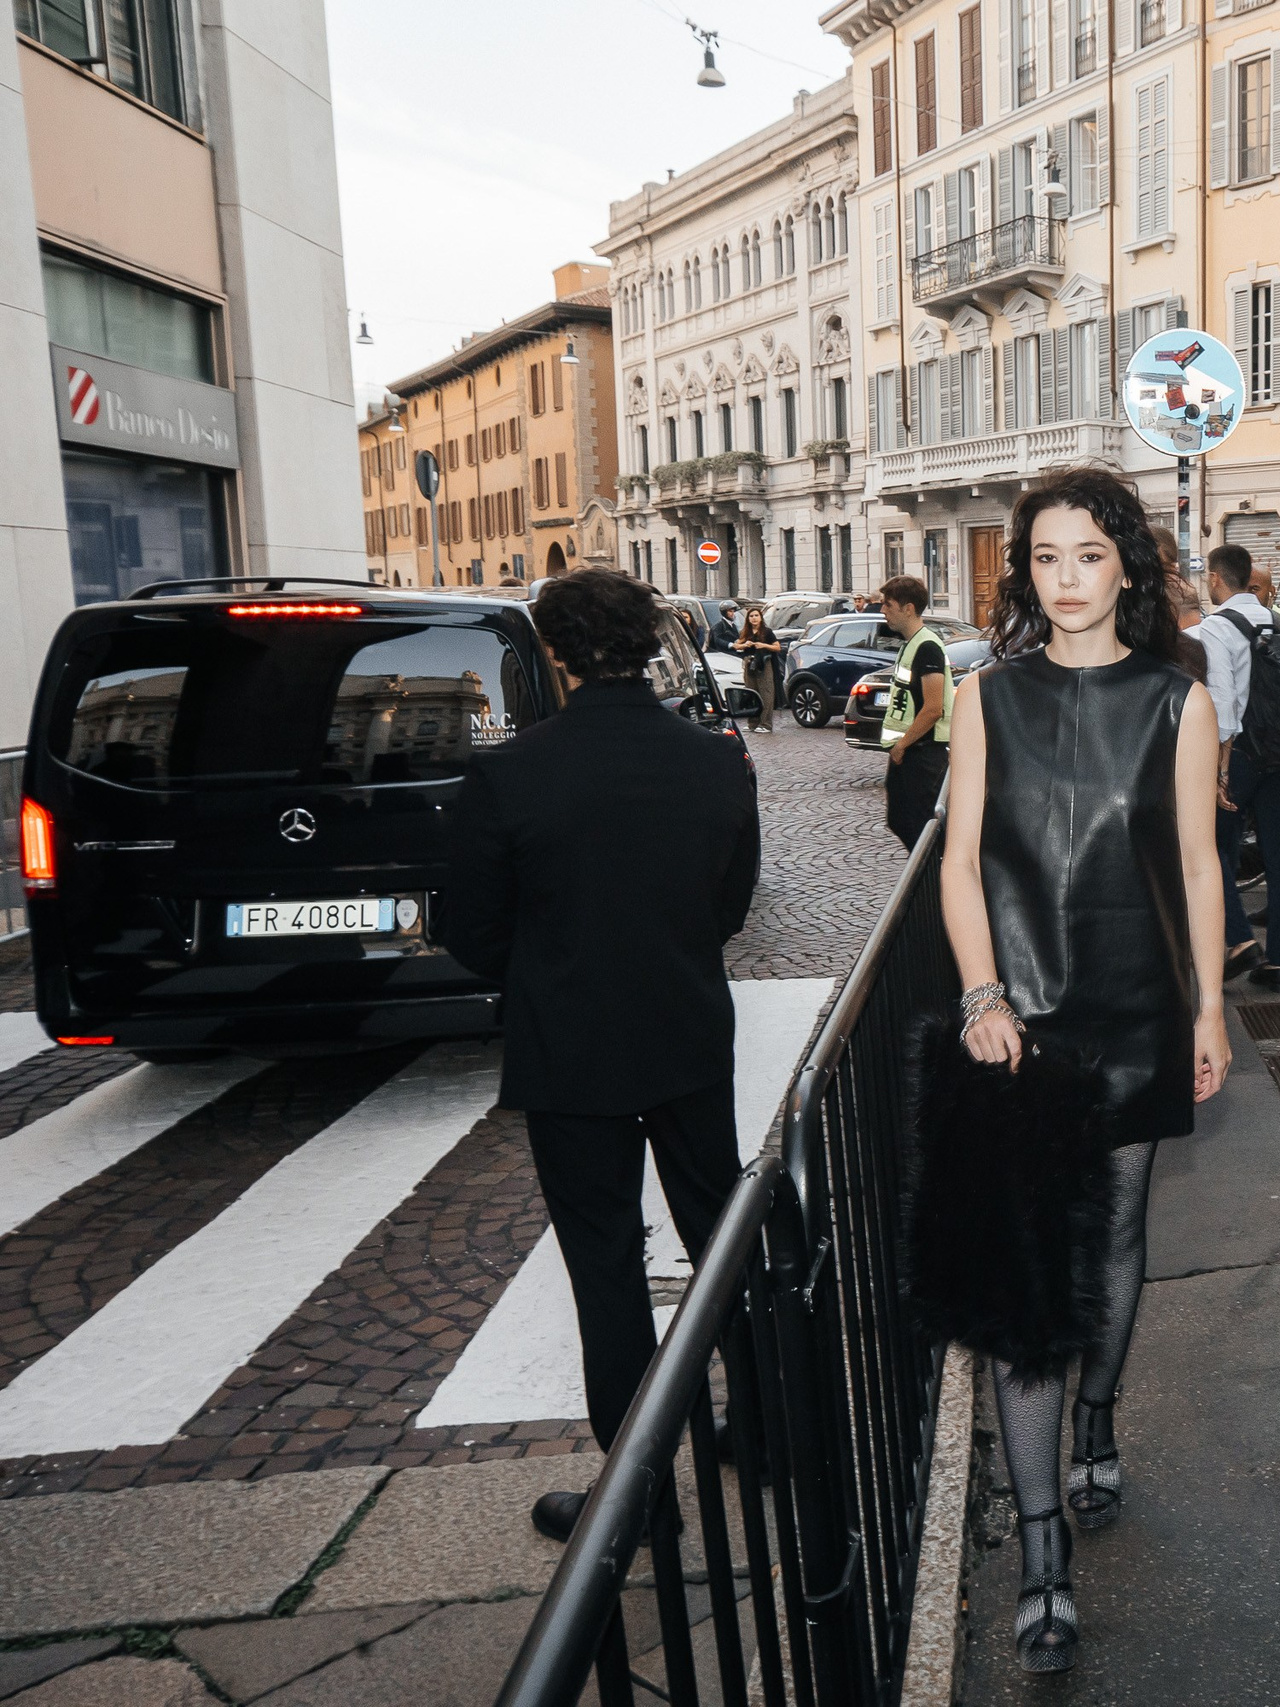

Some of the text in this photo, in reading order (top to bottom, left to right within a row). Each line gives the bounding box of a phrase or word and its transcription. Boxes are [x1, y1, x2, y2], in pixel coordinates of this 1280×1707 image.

[105, 390, 229, 450] Banco Desio
[470, 713, 517, 730] N.C.C.
[471, 731, 517, 740] NOLEGGIO
[248, 907, 279, 932] FR
[291, 904, 374, 930] 408CL
